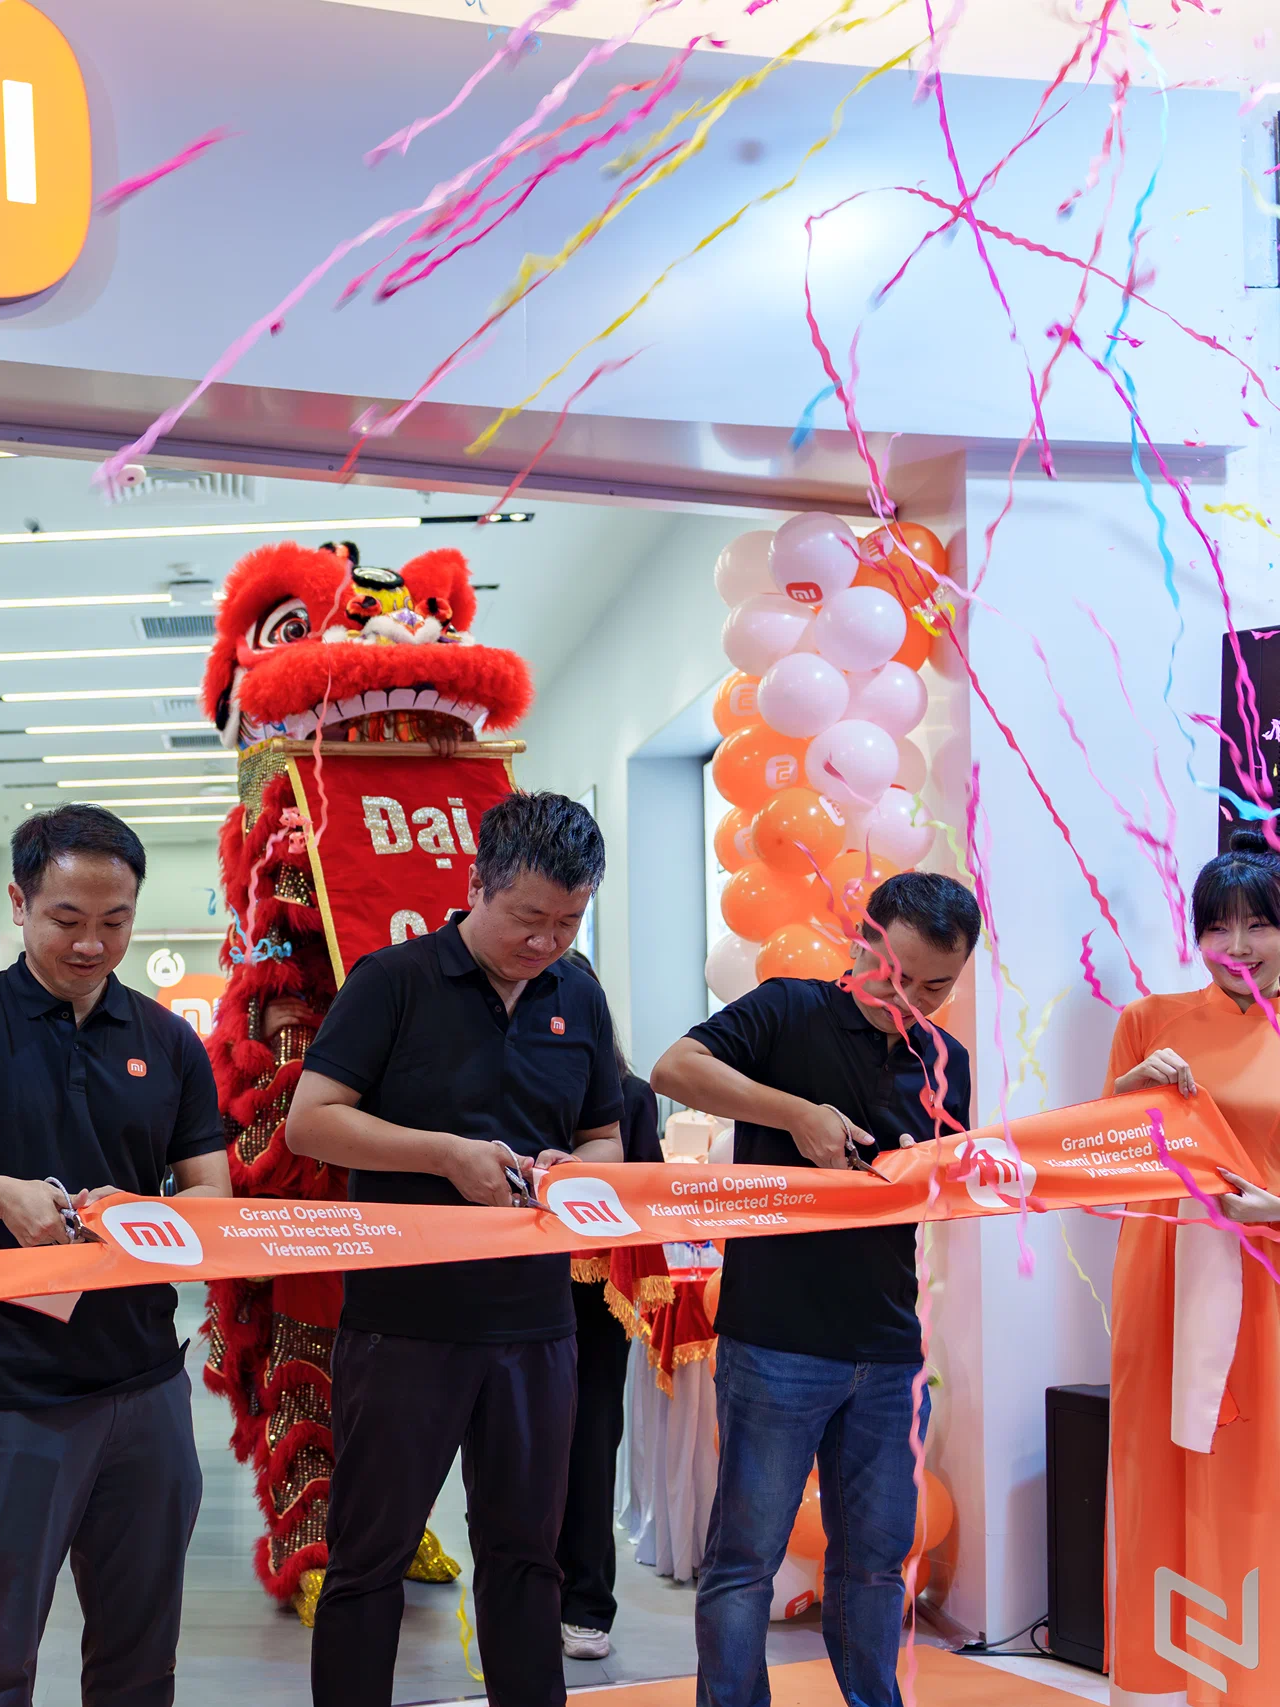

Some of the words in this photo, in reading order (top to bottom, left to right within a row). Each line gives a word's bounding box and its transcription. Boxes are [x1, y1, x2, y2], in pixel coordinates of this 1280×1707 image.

[361, 795, 478, 869] Đại
[1061, 1132, 1104, 1152] Grand
[1043, 1153, 1091, 1168] Xiaomi
[1090, 1142, 1153, 1166] Directed
[1154, 1136, 1198, 1153] tore,
[1083, 1166, 1139, 1178] Vietnam
[671, 1178, 718, 1196] Grand
[722, 1174, 787, 1194] Opening
[239, 1206, 291, 1221] Grand
[293, 1205, 363, 1223] Opening
[646, 1200, 701, 1218] Xiaomi
[703, 1194, 768, 1214] Directed
[772, 1193, 818, 1207] Store,
[685, 1217, 751, 1228] Vietnam
[749, 1212, 789, 1226] 2025
[218, 1224, 279, 1238] Xiaomi
[279, 1223, 351, 1238] Directed
[352, 1222, 402, 1237] Store,
[260, 1242, 332, 1257] Vietnam
[332, 1241, 374, 1256] 2025
